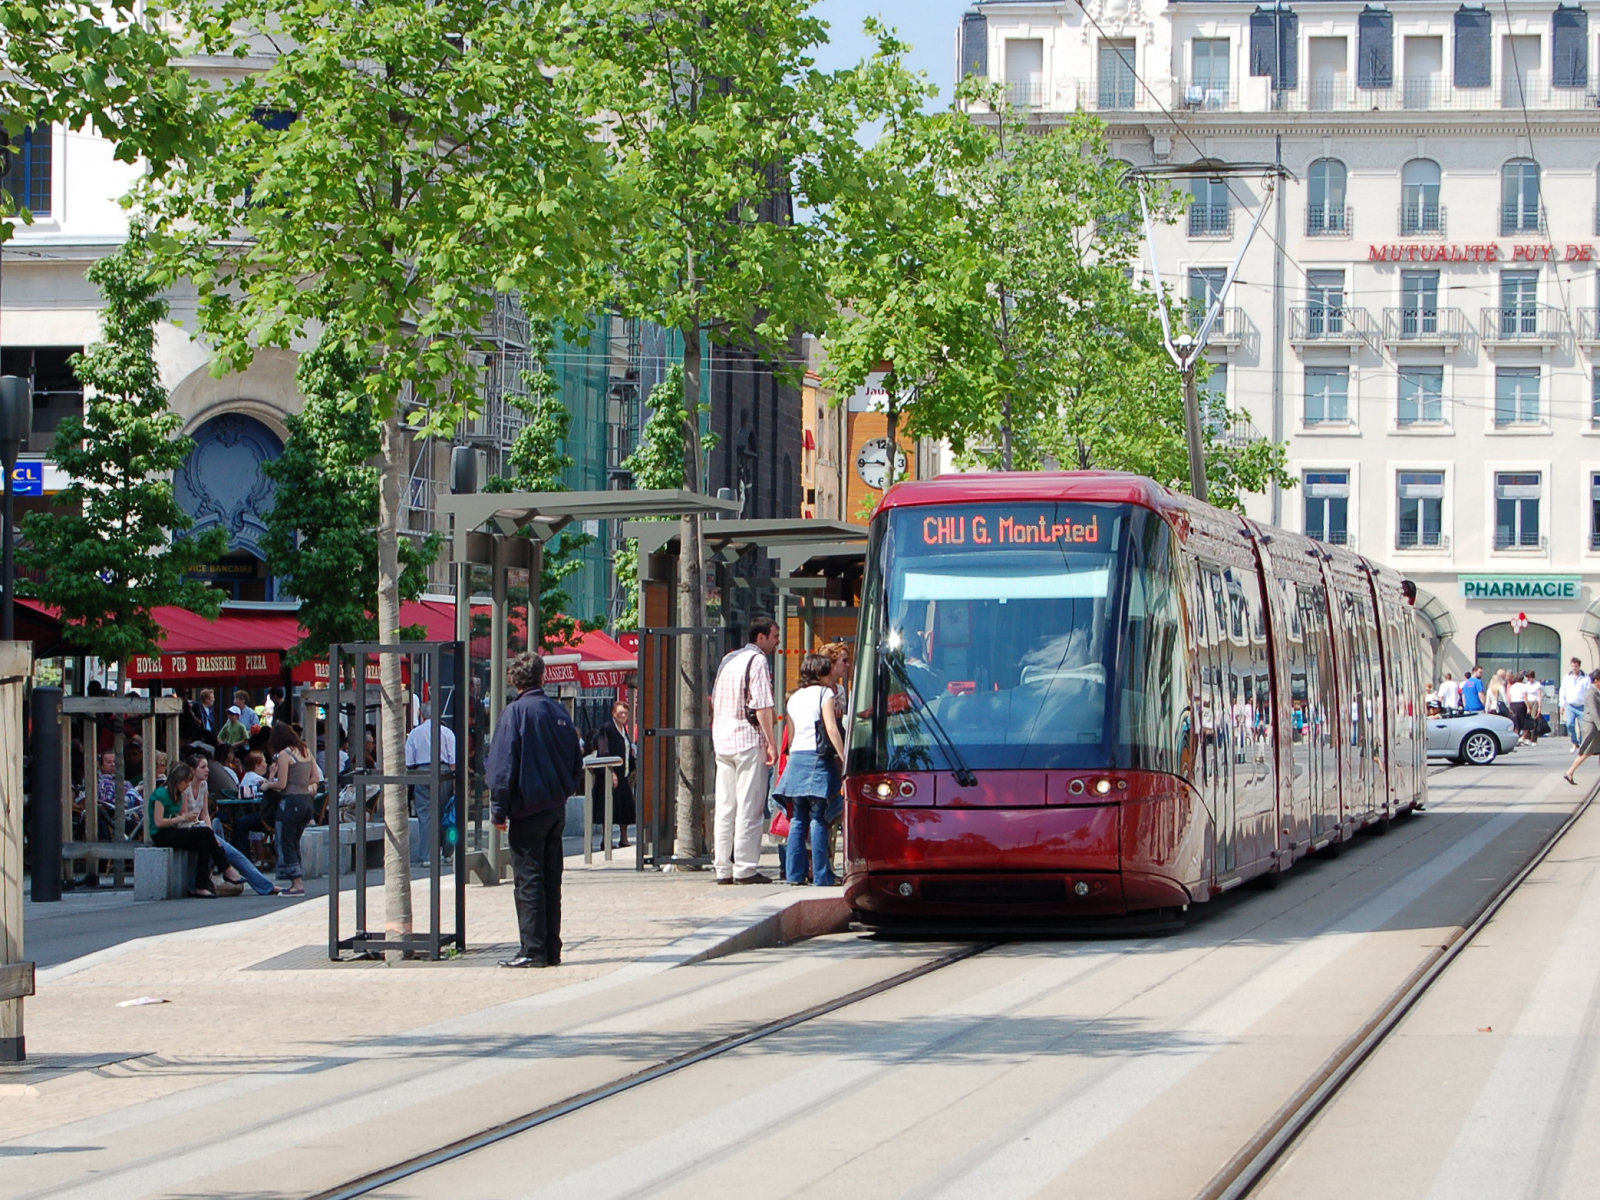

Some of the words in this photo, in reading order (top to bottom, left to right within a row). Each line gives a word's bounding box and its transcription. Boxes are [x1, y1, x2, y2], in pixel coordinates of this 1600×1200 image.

[1368, 241, 1498, 262] MUTUALITÉ
[1512, 244, 1552, 262] PUY
[1565, 244, 1593, 262] DE
[876, 440, 887, 450] 12
[897, 459, 905, 468] 3
[11, 468, 38, 480] CL
[923, 516, 966, 544] CHU
[972, 515, 992, 544] G.
[999, 514, 1098, 543] Montpied
[1464, 582, 1575, 597] PHARMACIE
[171, 657, 188, 672] PUB
[195, 656, 237, 672] BRASSERIE
[245, 655, 267, 670] PIZZA
[543, 665, 575, 681] RASSERIE
[587, 671, 608, 686] PLATS
